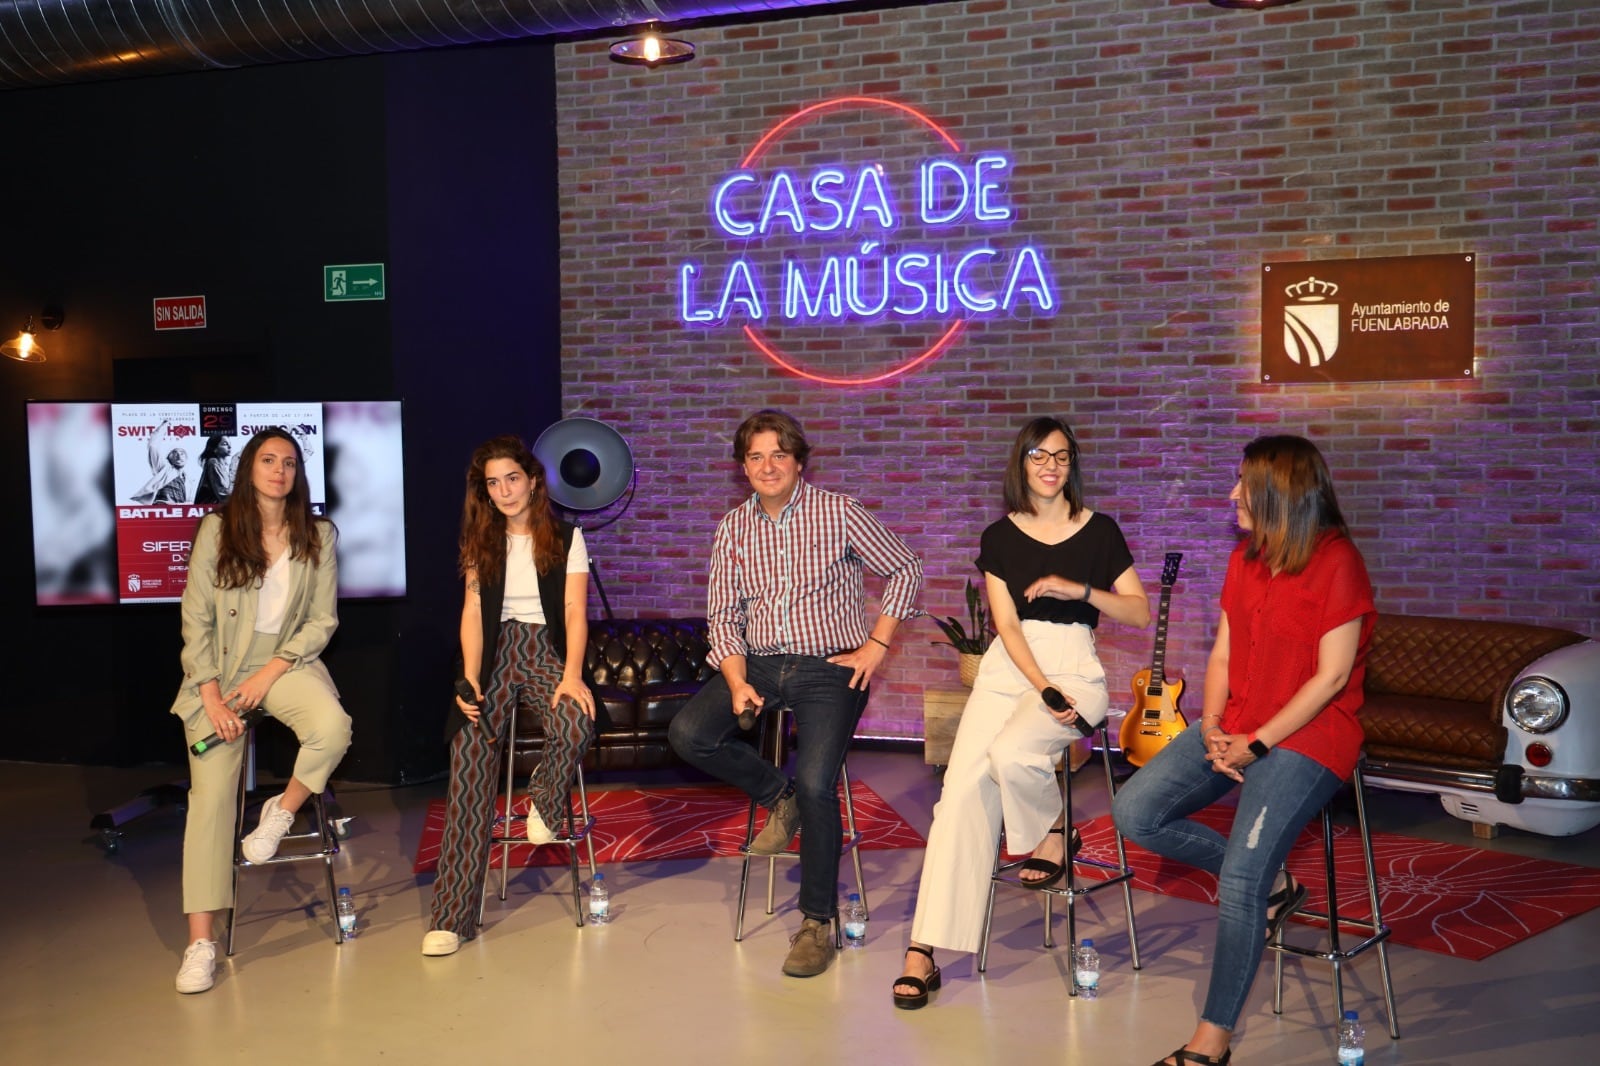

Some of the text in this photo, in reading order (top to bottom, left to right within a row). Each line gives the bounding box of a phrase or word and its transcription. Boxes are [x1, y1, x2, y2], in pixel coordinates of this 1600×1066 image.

[715, 156, 1011, 236] CASA DE
[682, 242, 1053, 322] LA MÚSICA
[156, 304, 204, 321] SIN SALIDA
[1351, 299, 1450, 319] Ayuntamiento de
[1351, 316, 1449, 332] FUENLABRADA
[119, 507, 183, 519] BATTLE
